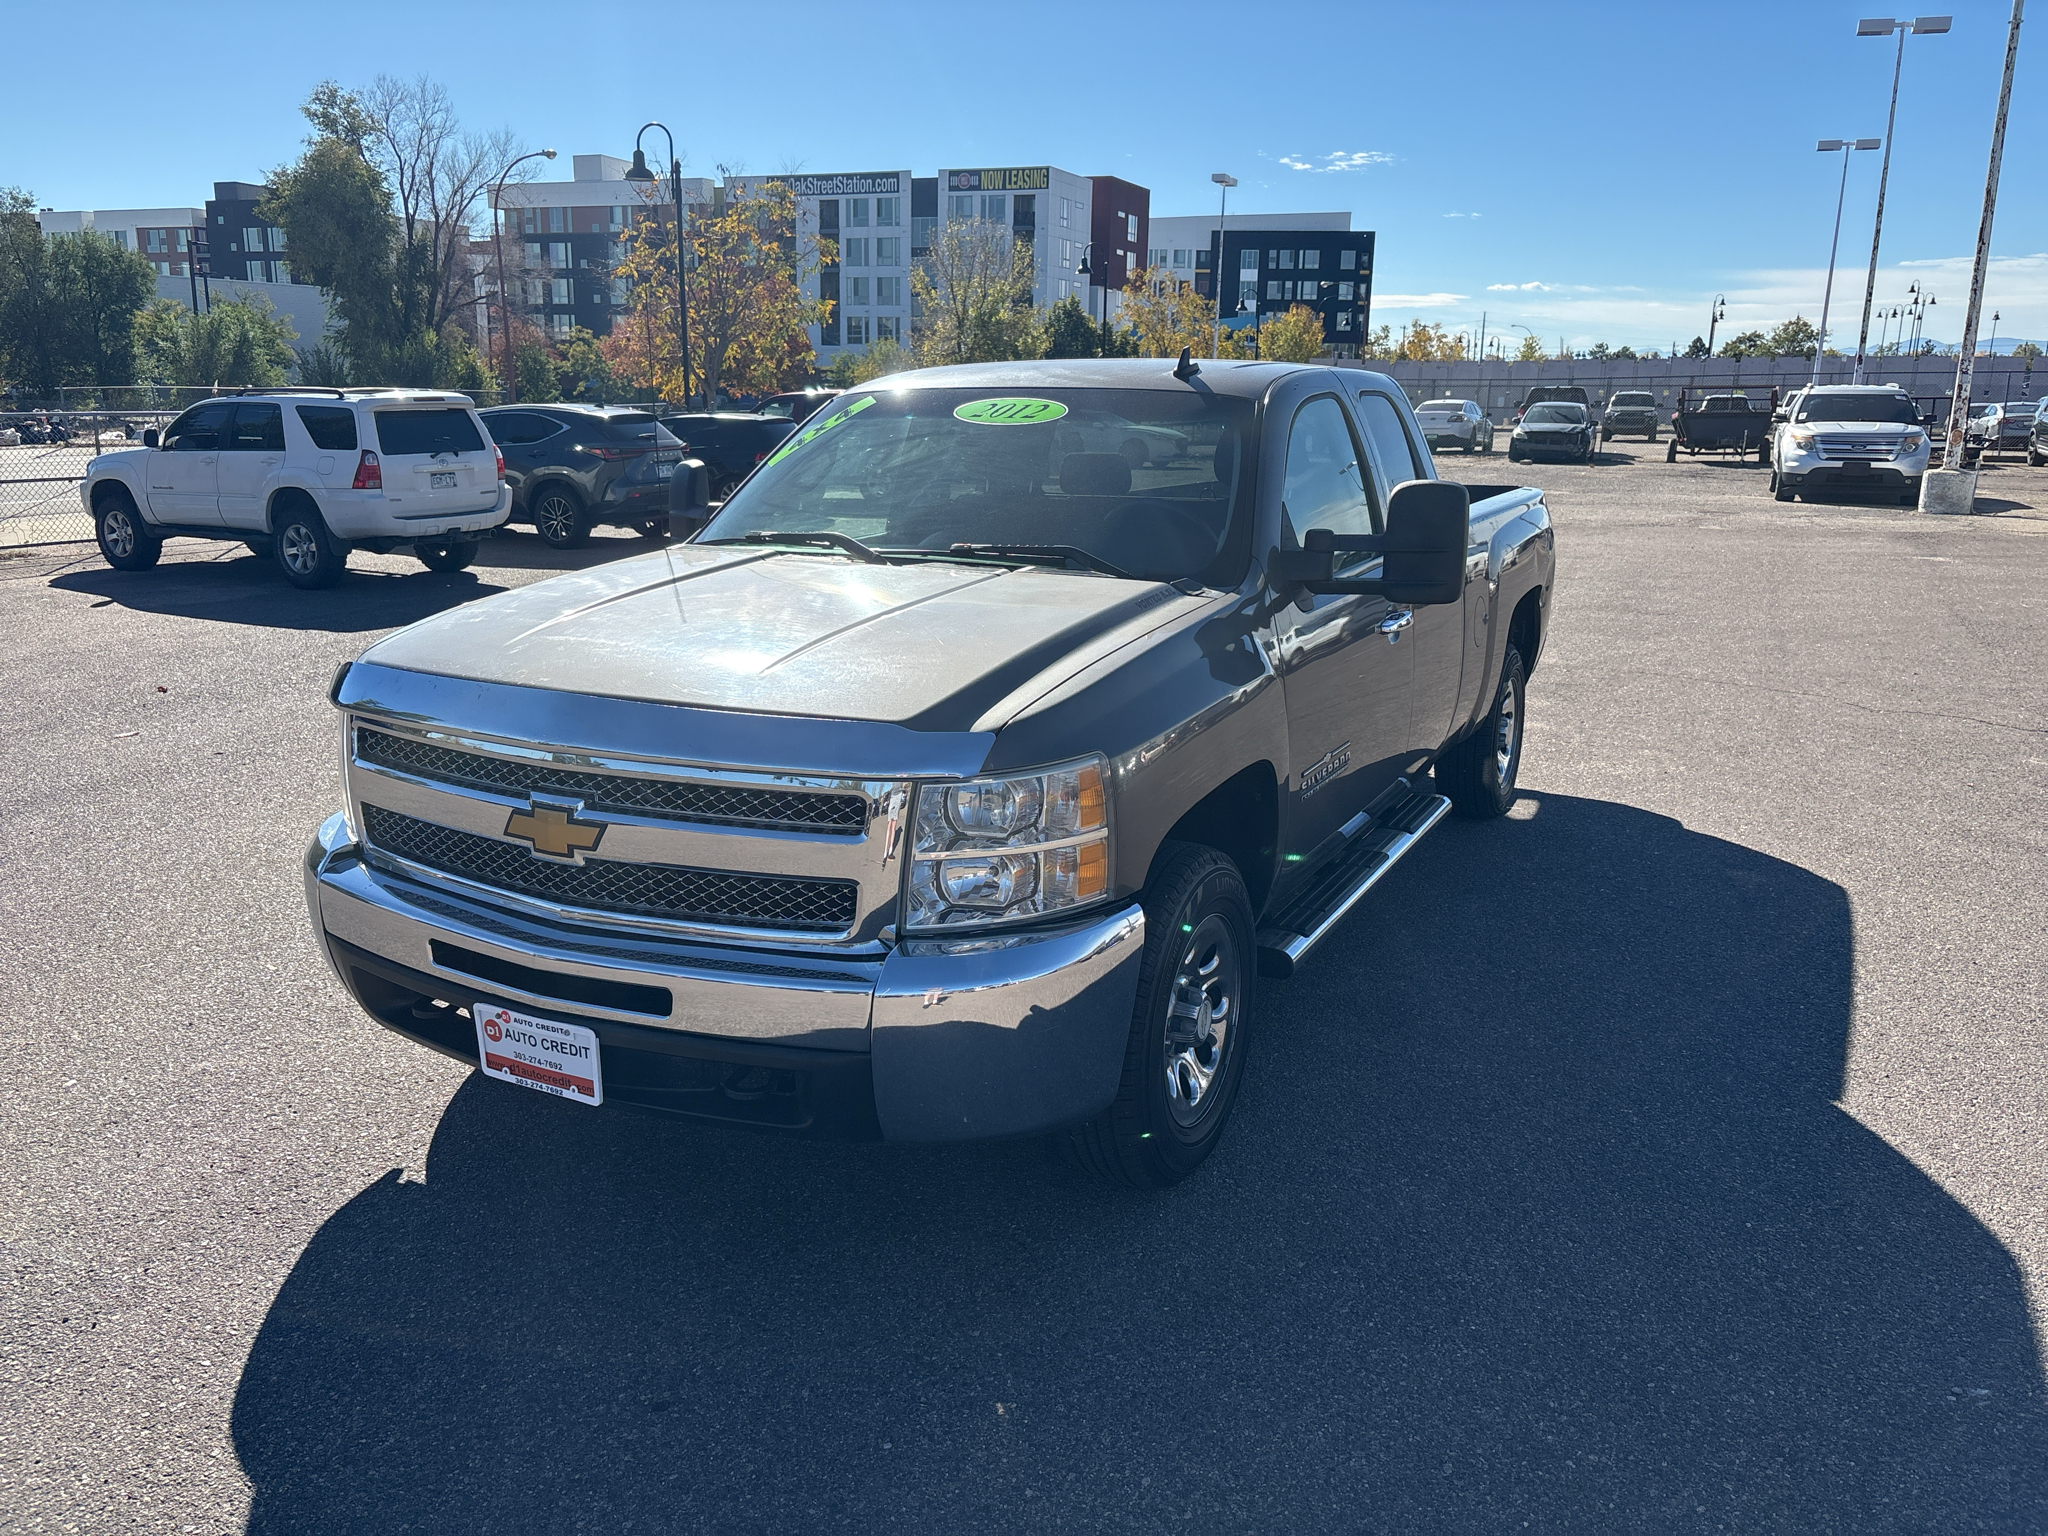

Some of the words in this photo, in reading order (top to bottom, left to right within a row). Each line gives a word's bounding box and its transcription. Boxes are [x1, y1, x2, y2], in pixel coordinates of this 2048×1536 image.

[981, 170, 1003, 190] NOW
[1006, 168, 1047, 189] LEASING
[969, 403, 1050, 418] 2012
[513, 1017, 533, 1028] AUTO
[536, 1023, 564, 1034] CREDIT
[486, 1025, 500, 1037] D1
[504, 1028, 537, 1047] AUTO
[541, 1038, 590, 1059] CREDIT
[513, 1051, 563, 1071] 303-274-7692
[515, 1078, 563, 1095] 303-274-7692
